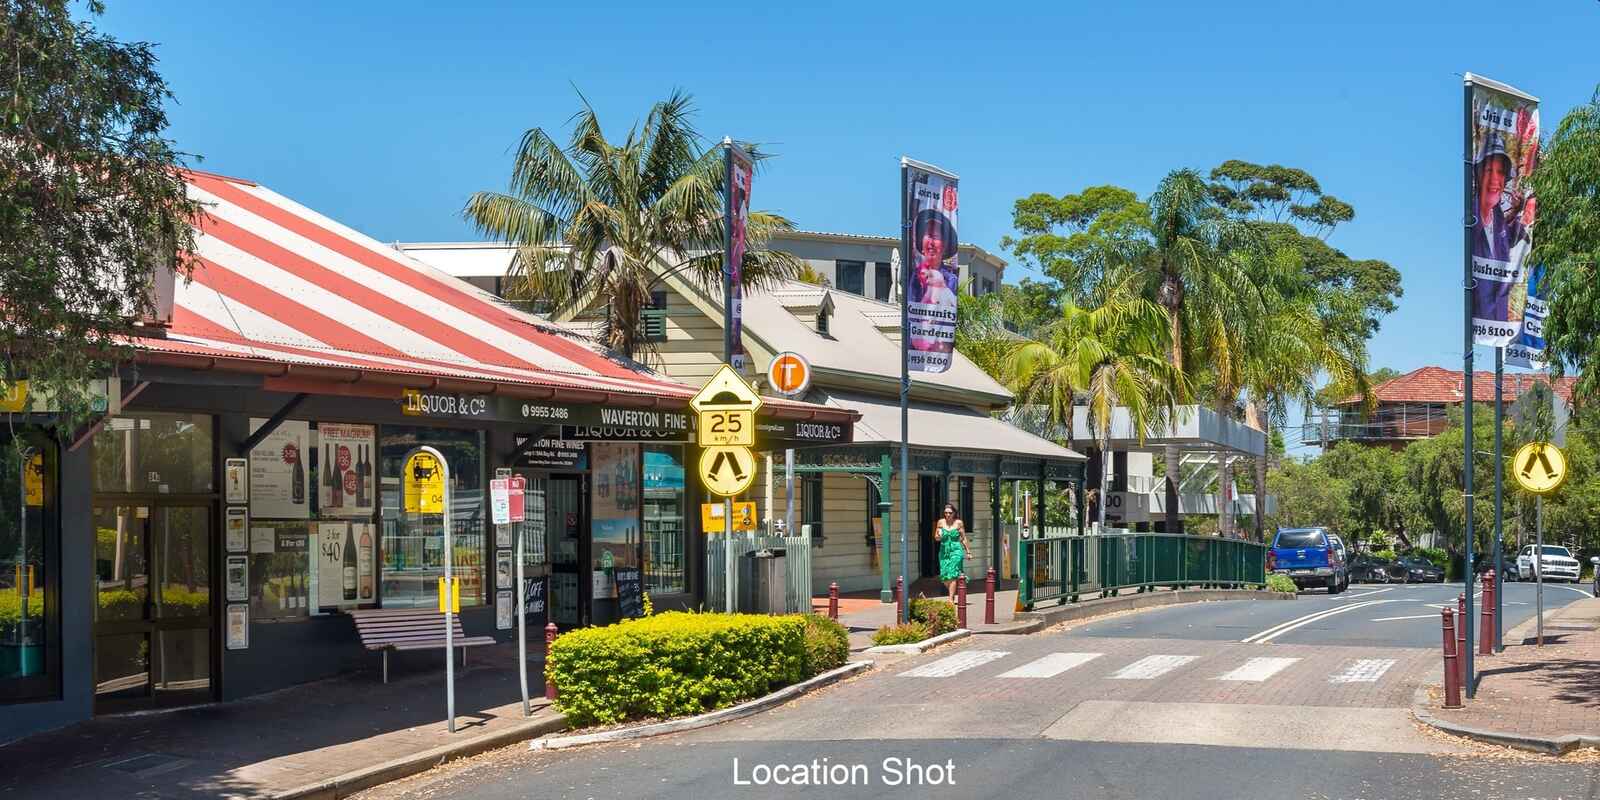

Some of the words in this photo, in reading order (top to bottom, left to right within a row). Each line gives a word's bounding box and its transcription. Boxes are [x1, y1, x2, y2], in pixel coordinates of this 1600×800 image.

[912, 326, 954, 338] Gardens
[1488, 326, 1514, 336] 8100
[1526, 321, 1541, 333] Car
[926, 356, 948, 366] 8100
[781, 364, 797, 386] T
[408, 394, 457, 414] LIQUOR
[458, 398, 468, 414] &
[531, 406, 550, 418] 9955
[550, 407, 568, 418] 2486
[601, 408, 659, 428] WAVERTON
[664, 414, 686, 429] FINE
[711, 414, 742, 432] 25
[796, 424, 823, 438] LIQUOR
[714, 434, 740, 444] km/h
[432, 495, 442, 504] 04
[322, 542, 340, 563] $40
